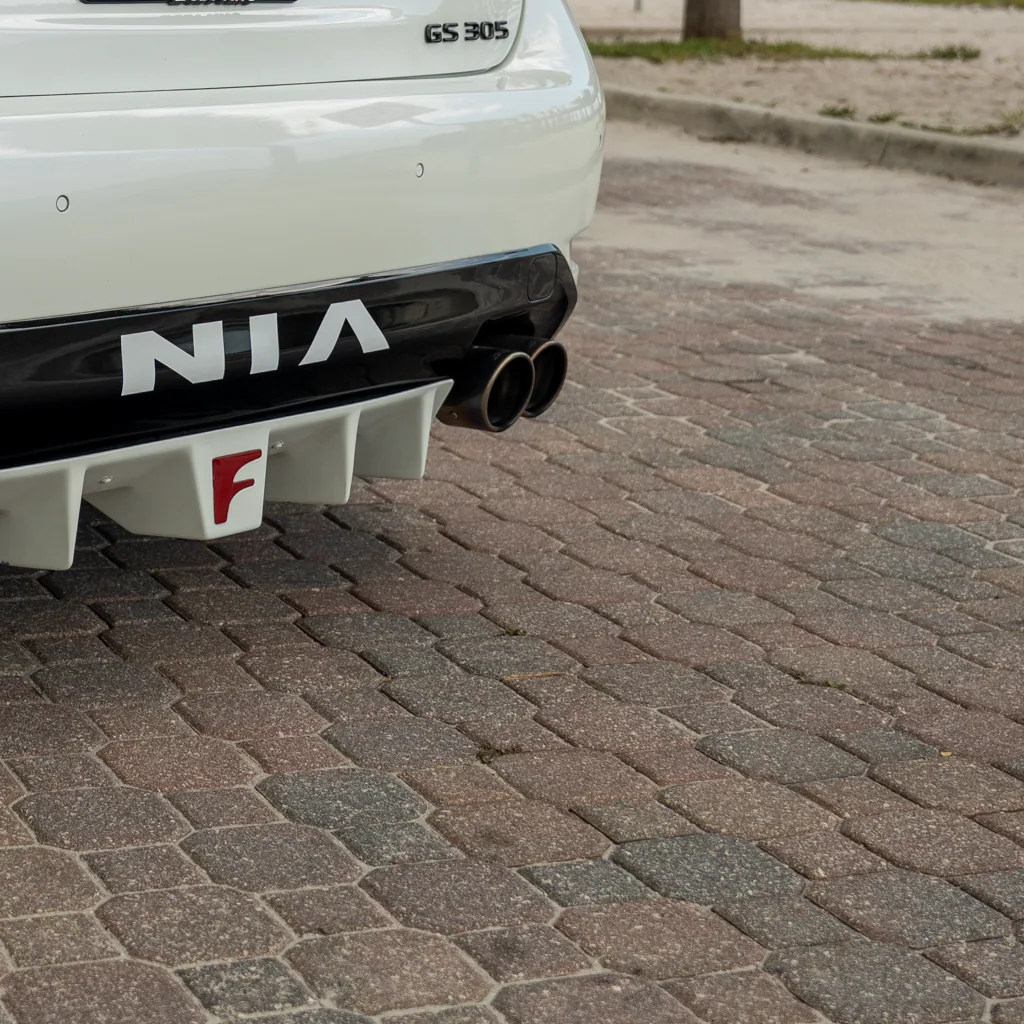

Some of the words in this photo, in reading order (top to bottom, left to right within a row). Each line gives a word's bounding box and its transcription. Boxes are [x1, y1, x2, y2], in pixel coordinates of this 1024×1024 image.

[424, 22, 460, 43] GS
[463, 20, 510, 41] 305
[121, 299, 389, 396] NIA
[212, 448, 262, 525] F
